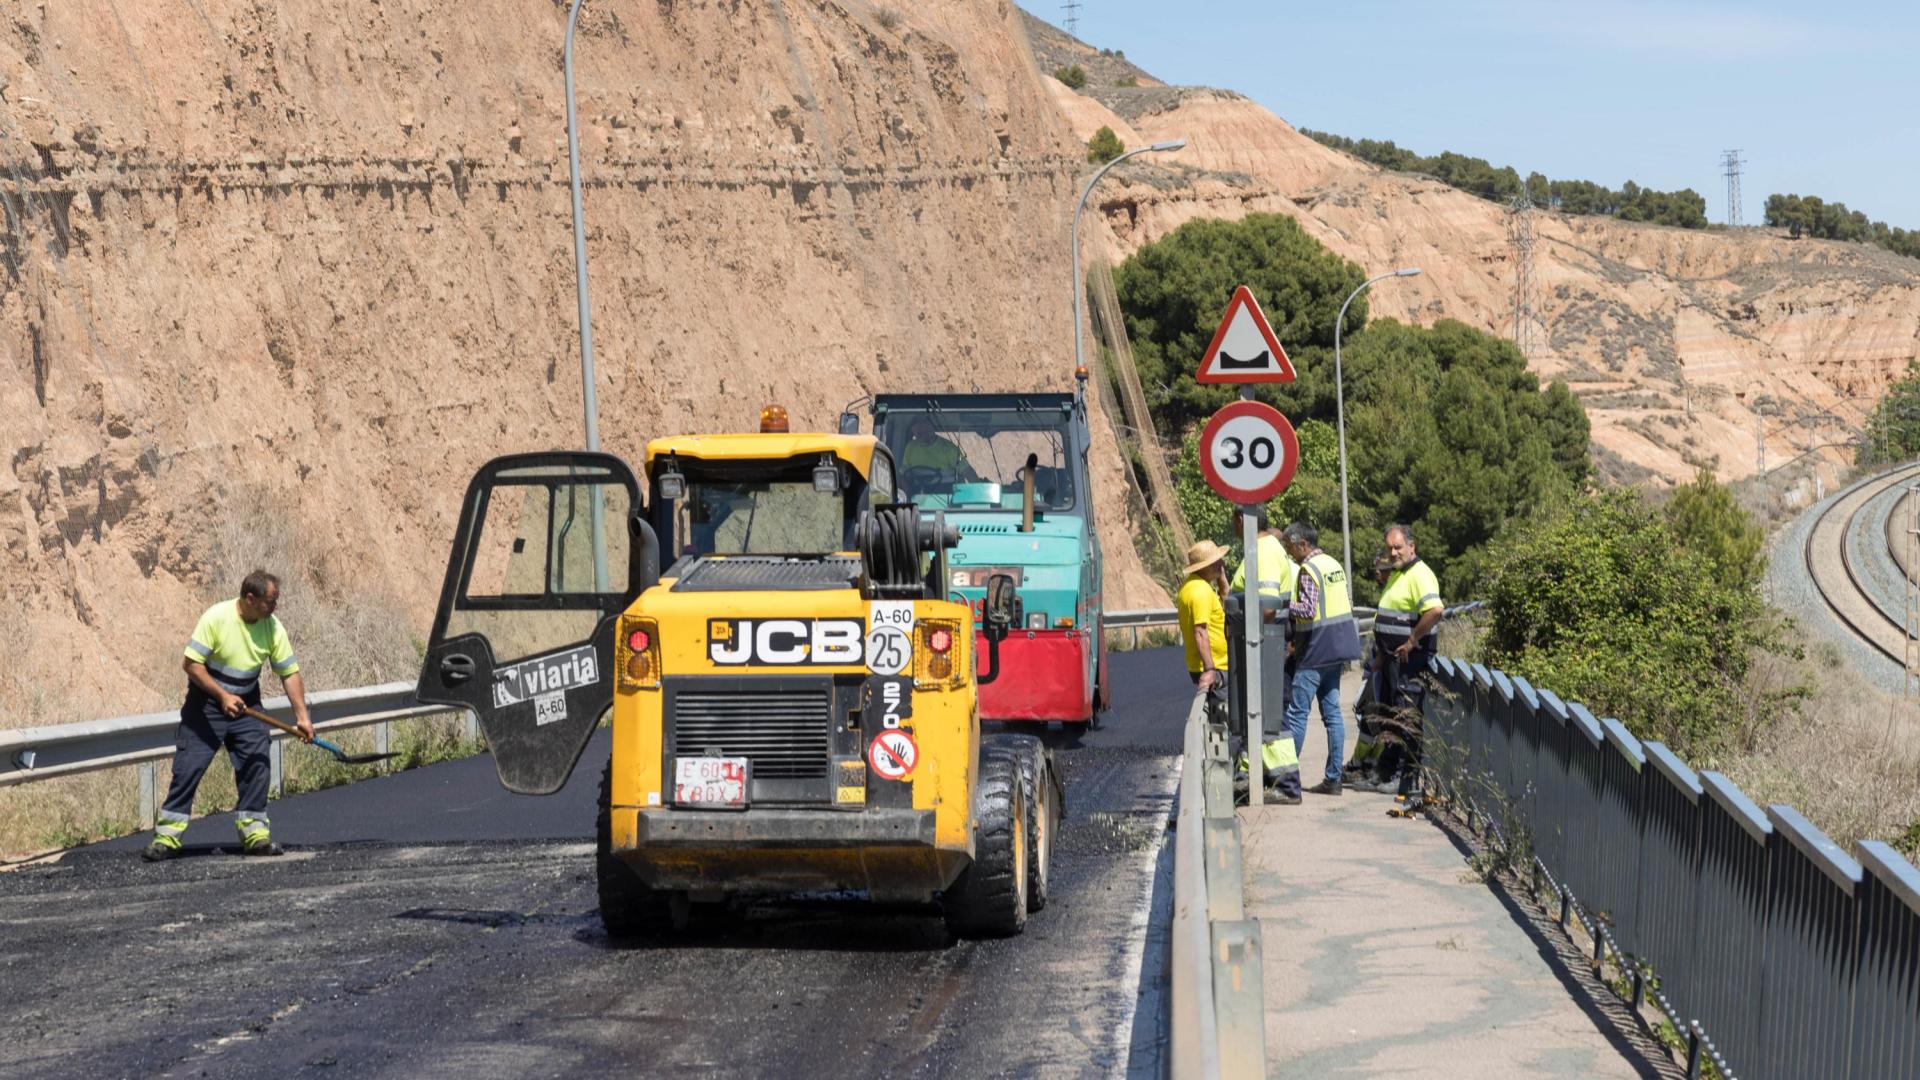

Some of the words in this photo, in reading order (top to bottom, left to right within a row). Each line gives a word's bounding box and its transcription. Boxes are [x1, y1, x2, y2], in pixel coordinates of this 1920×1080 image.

[1220, 436, 1275, 469] 30
[873, 609, 912, 624] A-60
[710, 620, 863, 664] JCB
[872, 632, 902, 669] 25
[524, 653, 596, 694] viaria
[538, 699, 565, 717] A-60
[883, 681, 900, 729] 270
